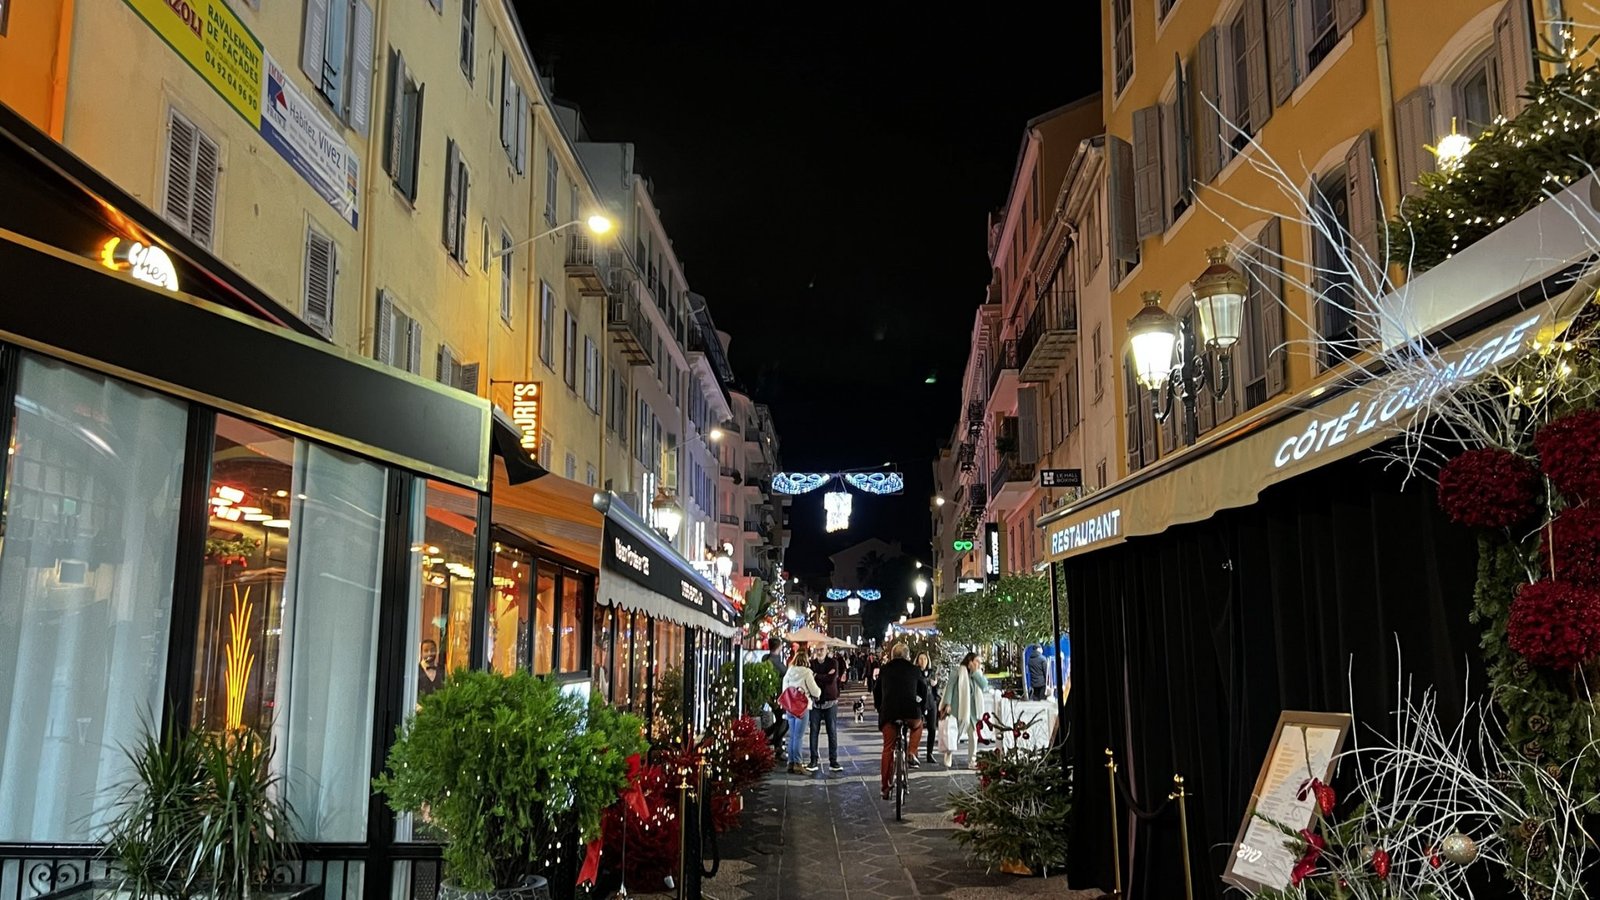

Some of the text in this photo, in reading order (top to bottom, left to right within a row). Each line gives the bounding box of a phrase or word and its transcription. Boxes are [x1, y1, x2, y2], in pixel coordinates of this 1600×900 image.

[207, 4, 259, 68] RAVALEMENT
[207, 20, 219, 42] DE
[222, 38, 259, 85] FAÇADES
[205, 50, 257, 111] 04 92 04 96 90
[290, 102, 317, 145] Habitez,
[319, 131, 341, 169] Vivez
[1274, 401, 1361, 468] CÔTÉ
[1052, 508, 1121, 555] RESTAURANT
